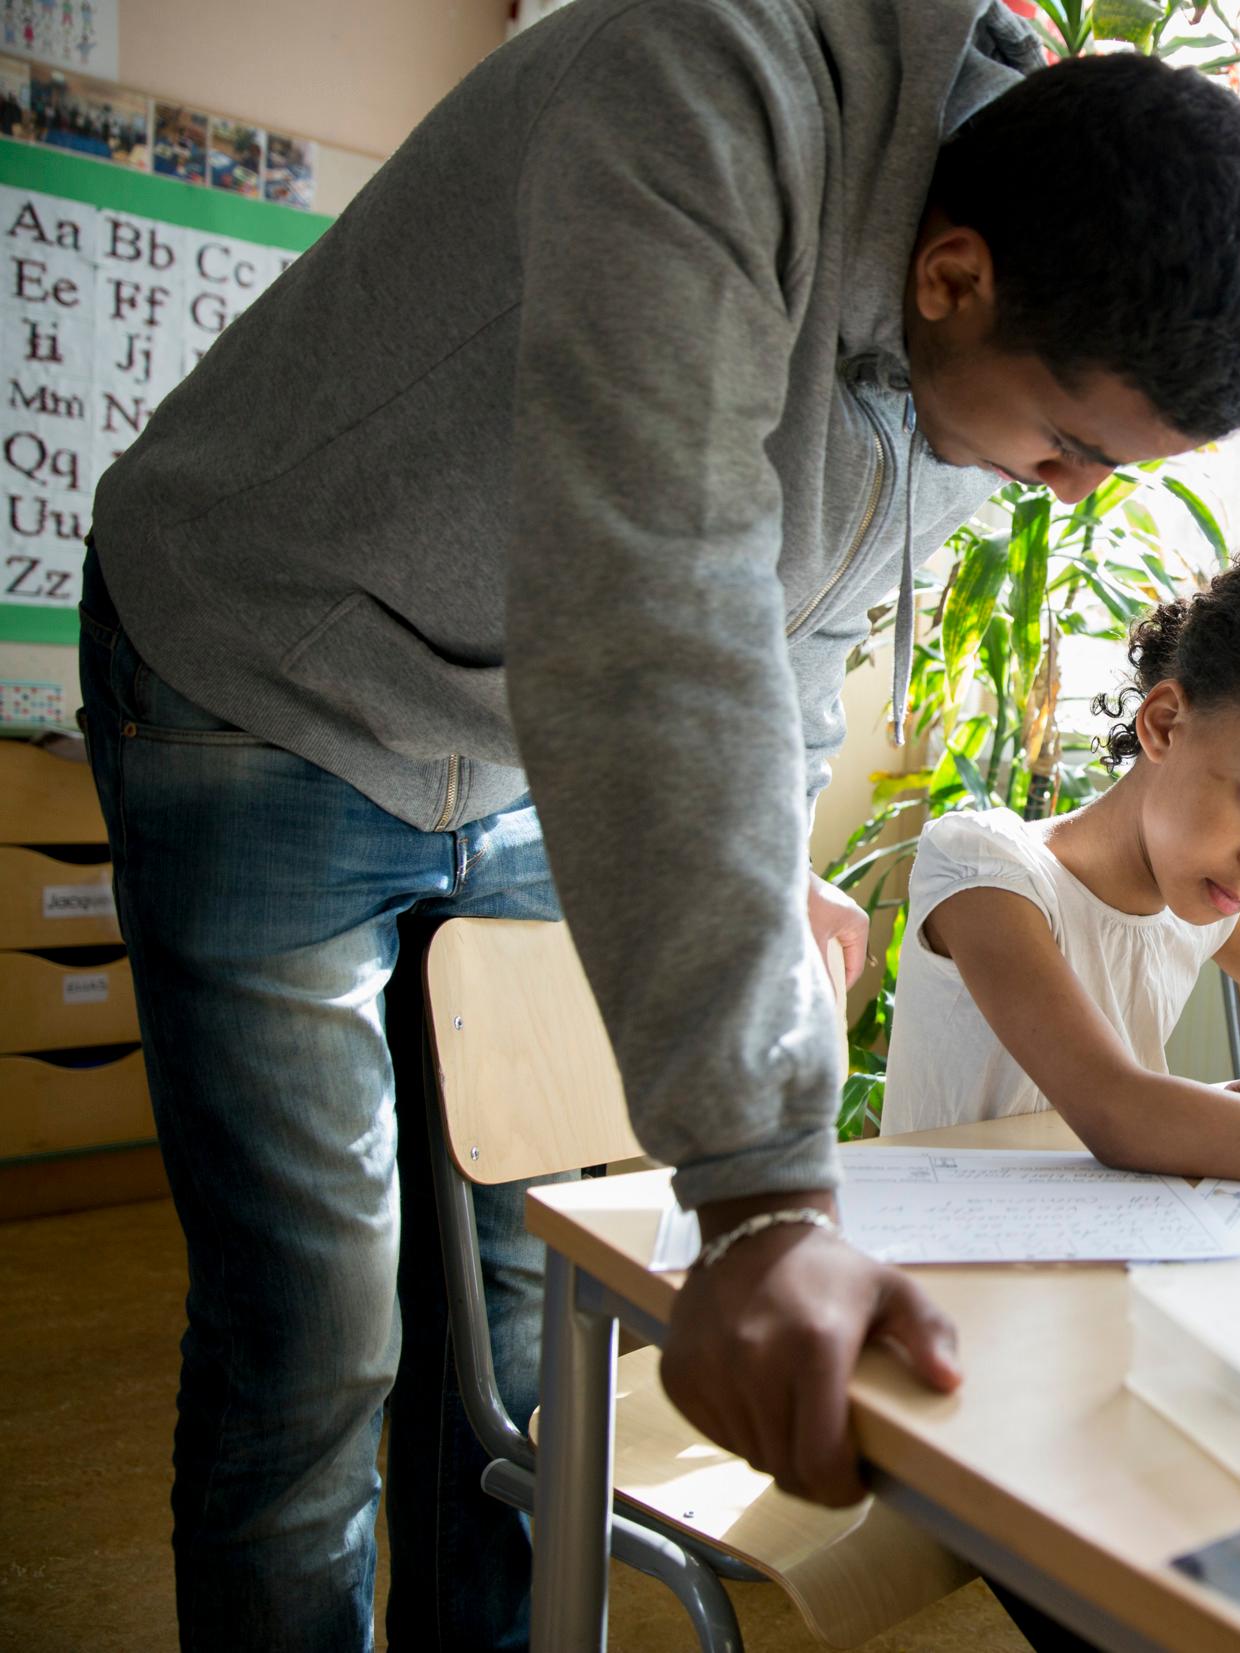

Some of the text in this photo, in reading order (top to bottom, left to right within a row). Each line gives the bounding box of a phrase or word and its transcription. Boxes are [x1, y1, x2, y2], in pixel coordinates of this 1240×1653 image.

[6, 199, 255, 288] Aa Bb Cc
[10, 255, 242, 334] Ee Ff G
[22, 317, 153, 385] Ii Jj
[9, 378, 154, 432] Mm N
[4, 430, 79, 490] Qq
[8, 495, 84, 541] Uu
[5, 555, 72, 599] Zz
